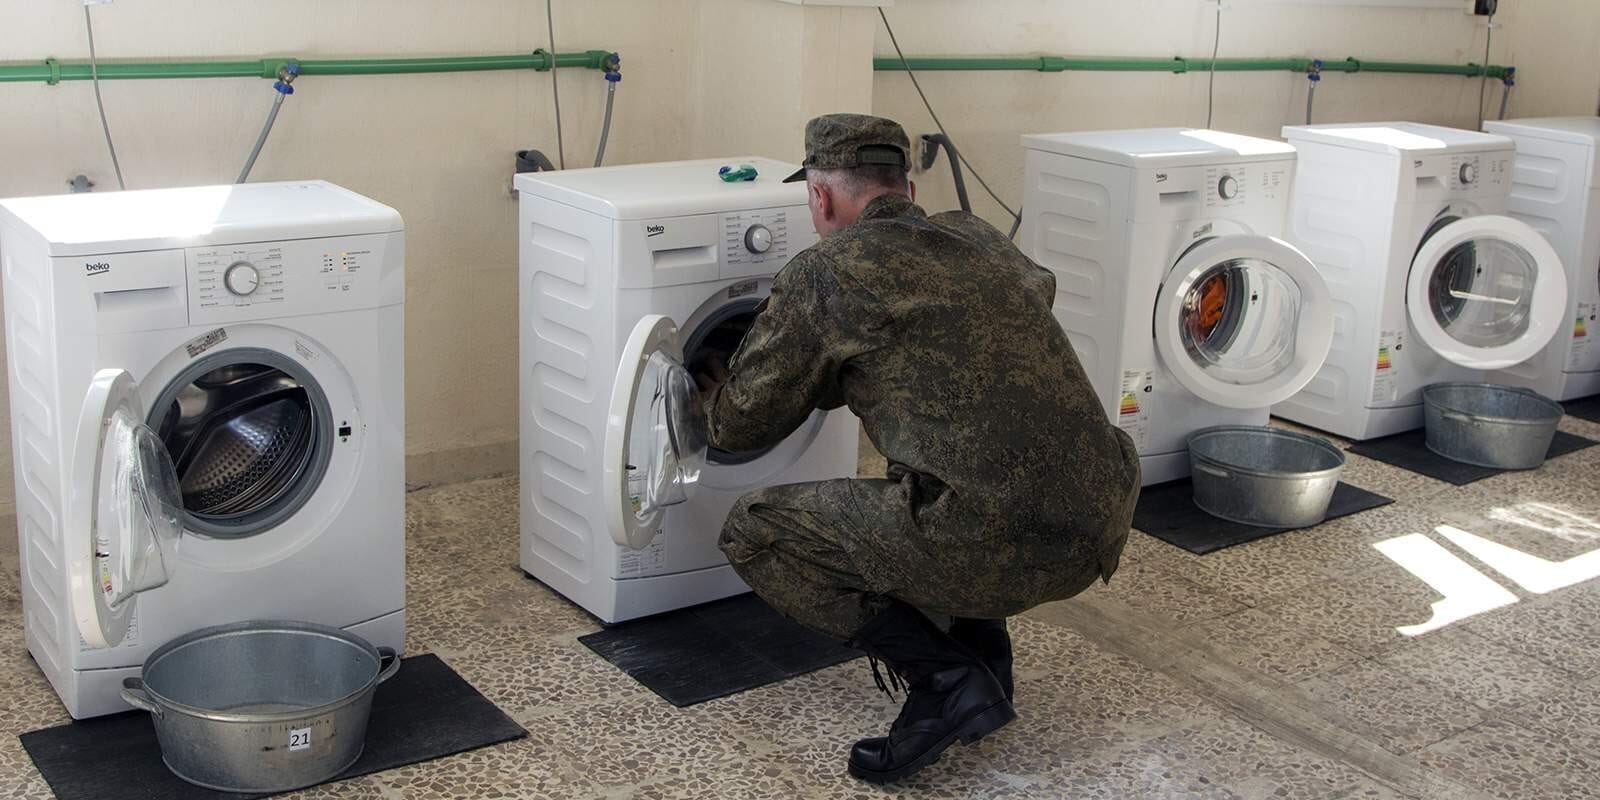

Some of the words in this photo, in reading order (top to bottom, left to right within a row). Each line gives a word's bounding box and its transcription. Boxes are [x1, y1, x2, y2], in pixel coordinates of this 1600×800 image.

[646, 224, 664, 233] beko
[86, 262, 109, 271] beko
[291, 733, 309, 747] 21
